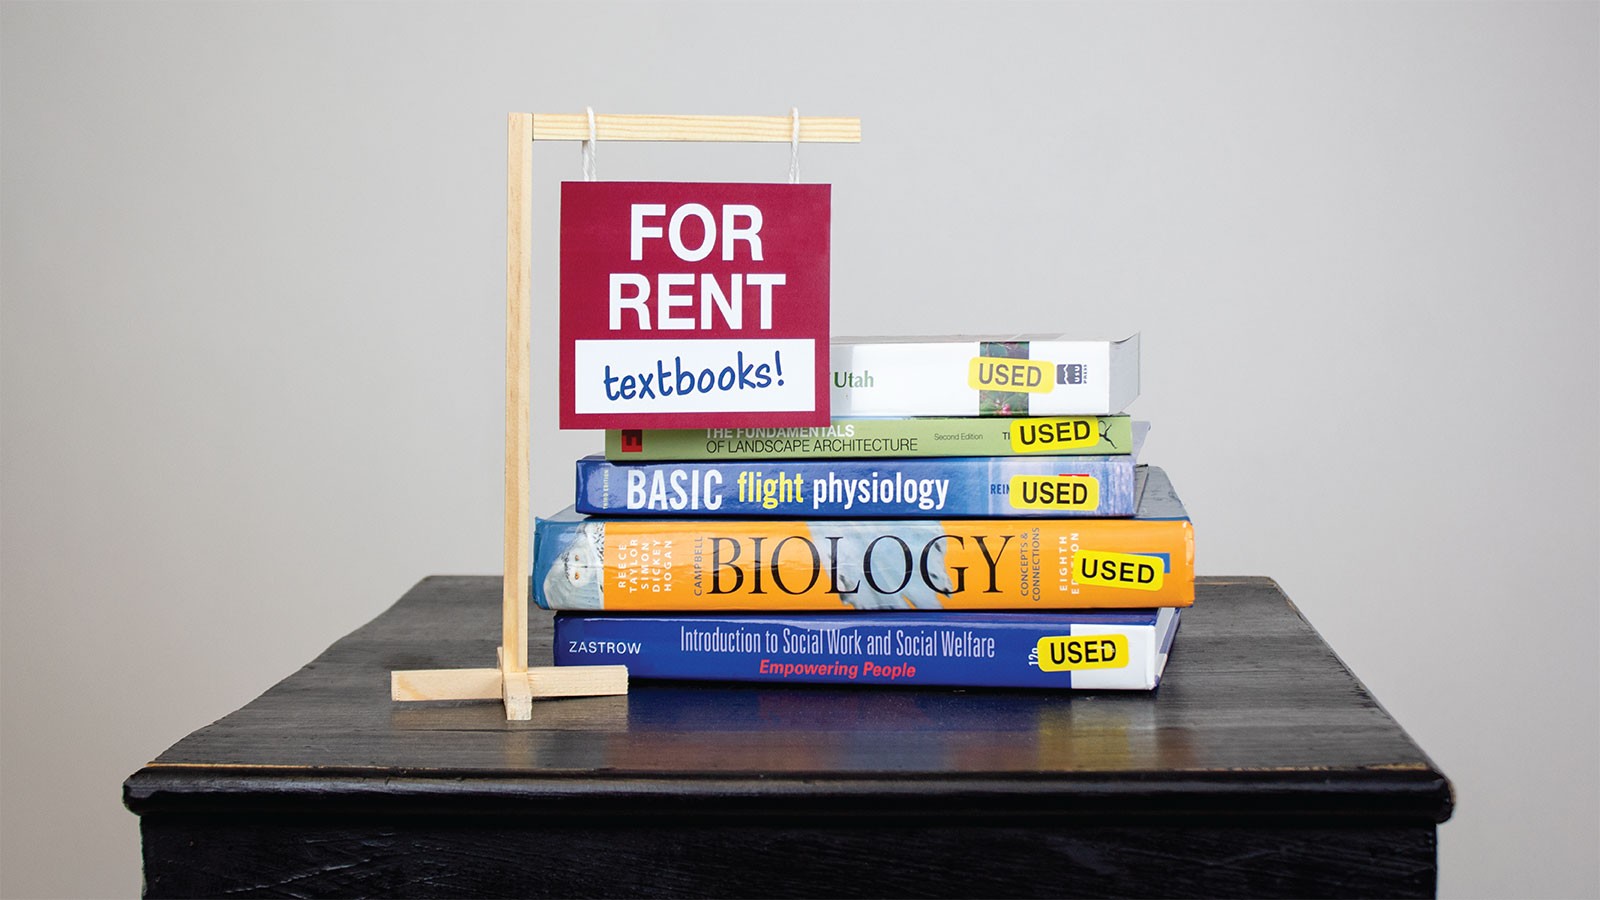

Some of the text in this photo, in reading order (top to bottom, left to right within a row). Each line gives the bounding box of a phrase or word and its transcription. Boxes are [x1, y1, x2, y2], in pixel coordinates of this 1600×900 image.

[630, 203, 764, 262] FOR
[609, 273, 786, 331] RENT
[603, 350, 785, 401] textbooks!
[833, 369, 875, 389] Utah
[978, 363, 1042, 388] USED
[706, 424, 855, 439] THE FUNDAMENTALS
[706, 438, 918, 453] OF LANDSCAPE ARCHITECTURE
[934, 432, 983, 441] Second Edition
[1019, 420, 1091, 446] USED
[627, 468, 950, 511] BASIC flight physiology
[1022, 481, 1088, 505] USED
[618, 544, 627, 588] REECE
[629, 539, 638, 593] TAYLOR
[641, 543, 650, 590] SIMON
[652, 540, 661, 593] DICKEY
[664, 540, 672, 592] HOGAN
[694, 536, 703, 597] CAMPBELL
[707, 535, 1015, 596] BIOLOGY
[1020, 532, 1029, 597] CONCEPTS &
[1032, 527, 1041, 602] CONNECTIONS
[1059, 536, 1068, 591] EIGHTH
[1081, 558, 1155, 584] USED
[569, 641, 642, 655] ZASTROW
[680, 626, 995, 658] Introduction to Social Work and Social Welfare
[1050, 640, 1117, 665] USED
[759, 659, 916, 680] Empowering People
